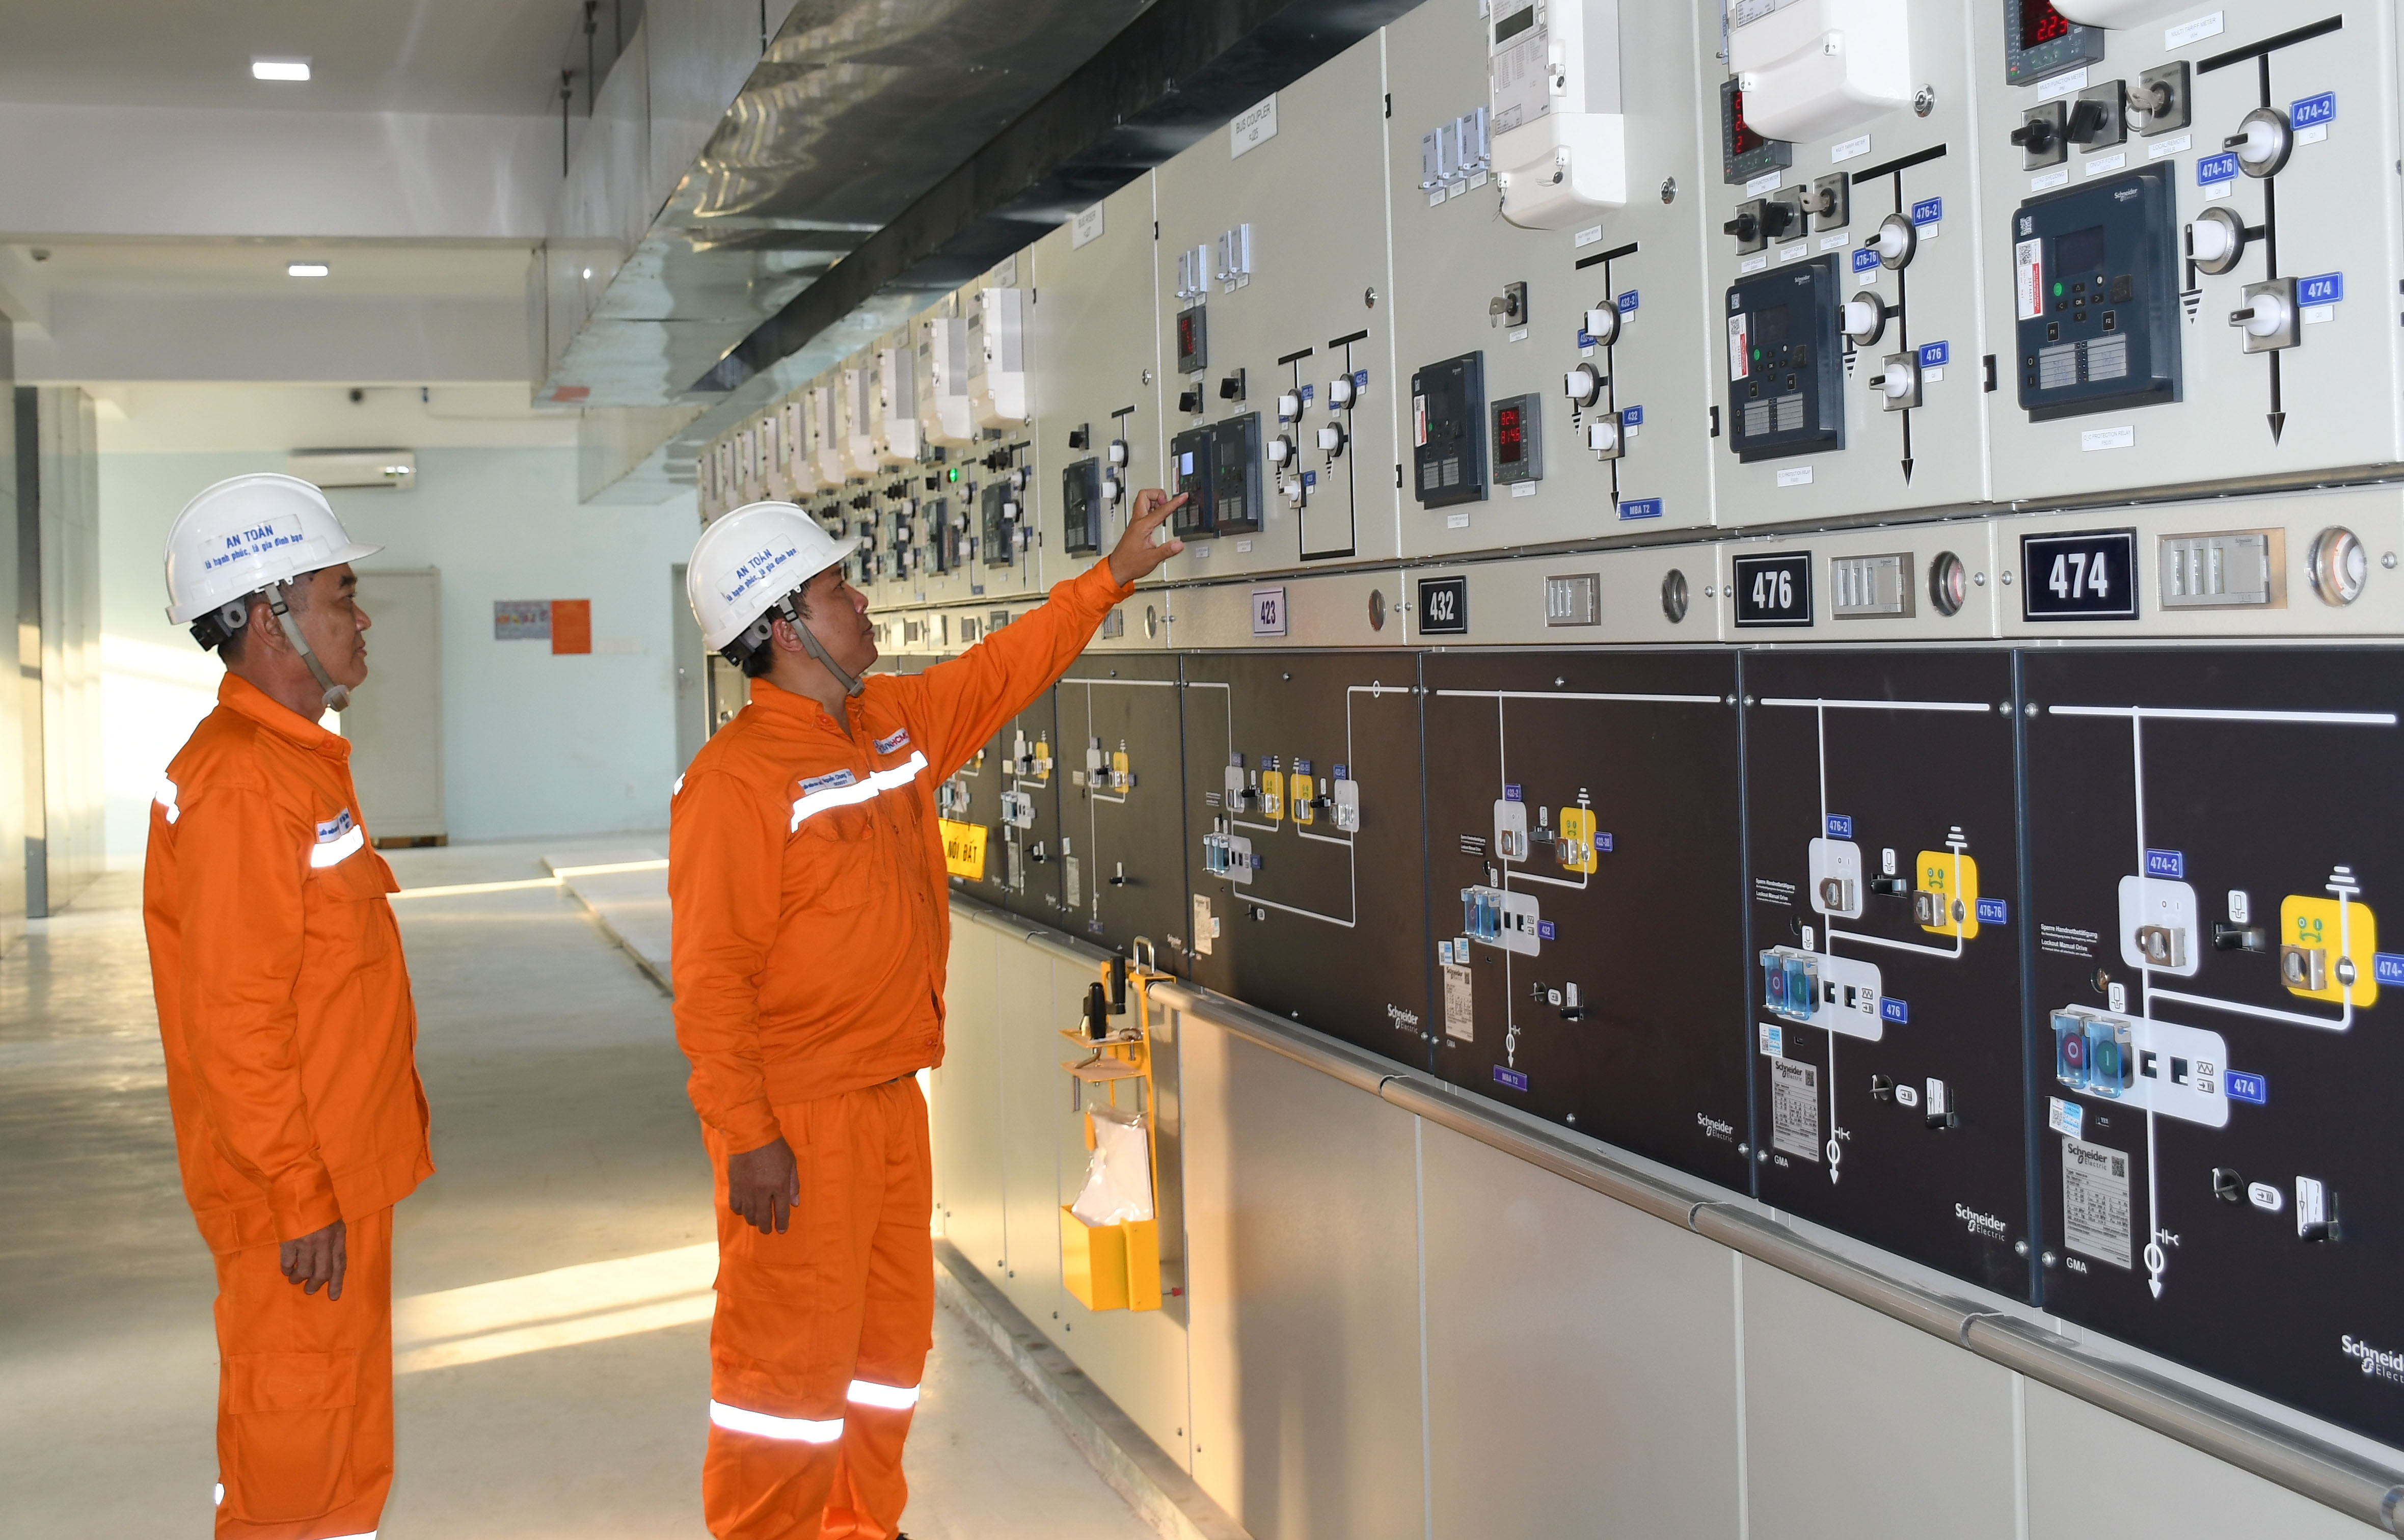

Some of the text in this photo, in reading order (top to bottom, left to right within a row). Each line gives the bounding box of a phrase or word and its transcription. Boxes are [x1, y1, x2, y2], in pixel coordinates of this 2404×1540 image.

[2200, 17, 2217, 29] METER
[2070, 71, 2085, 81] METER
[2297, 100, 2329, 122] 474-2
[2202, 158, 2232, 178] 474-76
[2114, 188, 2138, 199] Schneider
[1916, 204, 1937, 220] 476-2
[1856, 251, 1877, 266] 476-76
[2308, 281, 2331, 298] 474
[1620, 295, 1635, 308] 432-2
[1927, 348, 1941, 361] 476
[1628, 411, 1638, 421] 432
[2092, 431, 2117, 439] PROTECTION
[1630, 504, 1650, 515] MBA T2
[226, 525, 274, 549] AN TOÀN
[205, 533, 304, 570] là hạnh phúc, là gia đình bạn
[736, 548, 773, 580] AN TOÀN
[766, 562, 775, 573] gia
[2049, 552, 2108, 599] 474
[1752, 570, 1792, 609] 476
[1260, 600, 1276, 625] 423
[1429, 590, 1454, 622] 432
[1507, 788, 1519, 798] 432-2
[1829, 820, 1848, 832] 476-2
[2150, 856, 2178, 872] 474-2
[1979, 905, 2002, 918] 476-76
[1541, 925, 1551, 935] 432
[2041, 923, 2056, 932] Sperre
[2041, 938, 2059, 947] Lockout
[2059, 941, 2075, 950] Manual
[2380, 961, 2404, 978] 474-
[1387, 1003, 1419, 1025] Schneider
[1886, 1004, 1901, 1017] 476
[1775, 1061, 1803, 1076] Schneider
[1501, 1072, 1519, 1085] MBA T2
[1787, 1071, 1802, 1082] Electric
[2234, 1078, 2255, 1095] 474
[1697, 1112, 1734, 1134] Schneider
[1712, 1129, 1733, 1143] Electric
[2067, 1143, 2108, 1163] Schneider
[1774, 1154, 1789, 1168] GMA
[2084, 1157, 2106, 1171] Electric
[1955, 1202, 2006, 1232] Schneider
[1977, 1224, 2005, 1242] Electric
[2066, 1257, 2087, 1274] GMA
[2341, 1334, 2404, 1372] Schneid
